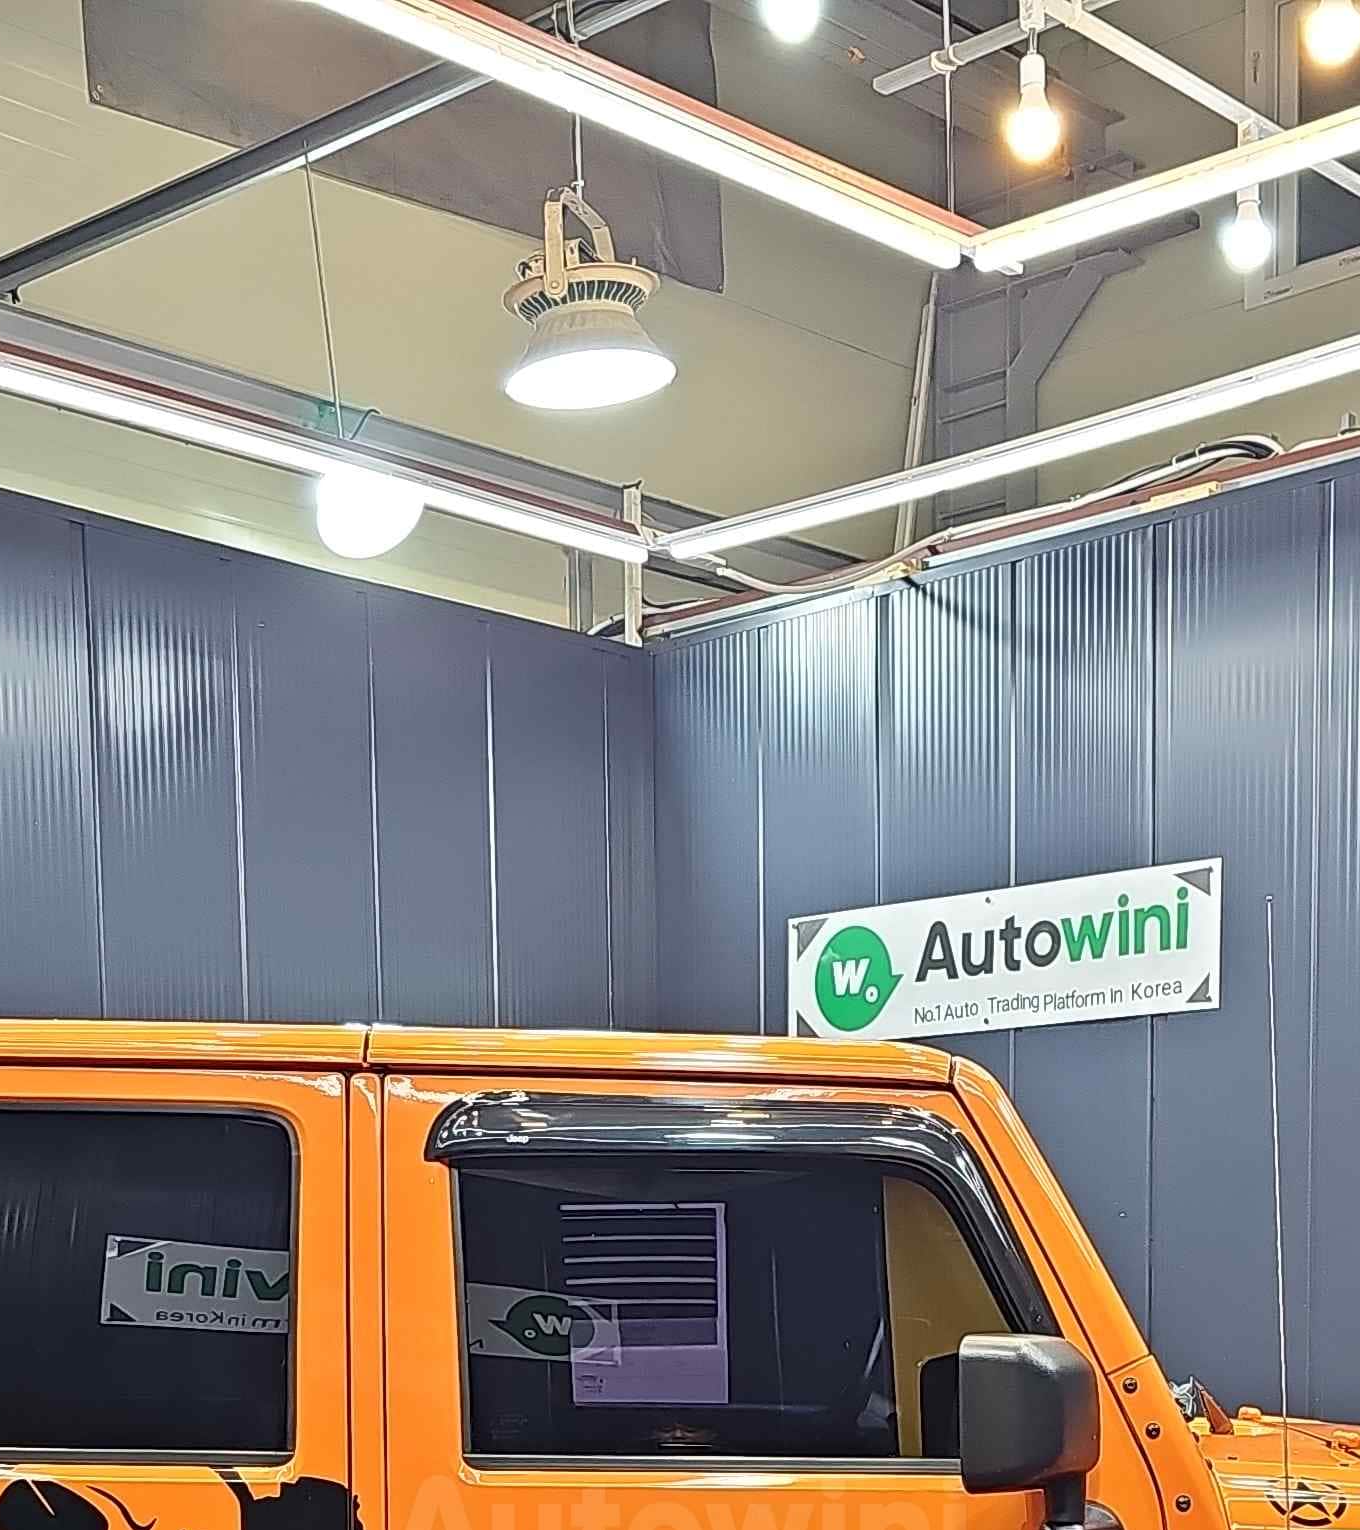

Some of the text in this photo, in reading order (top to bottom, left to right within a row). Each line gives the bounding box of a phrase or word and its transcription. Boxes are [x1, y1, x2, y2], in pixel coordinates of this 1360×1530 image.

[915, 887, 1190, 983] Autowini
[987, 992, 1040, 1013] Trading
[1043, 989, 1106, 1012] Platform
[1131, 980, 1183, 1001] Korea
